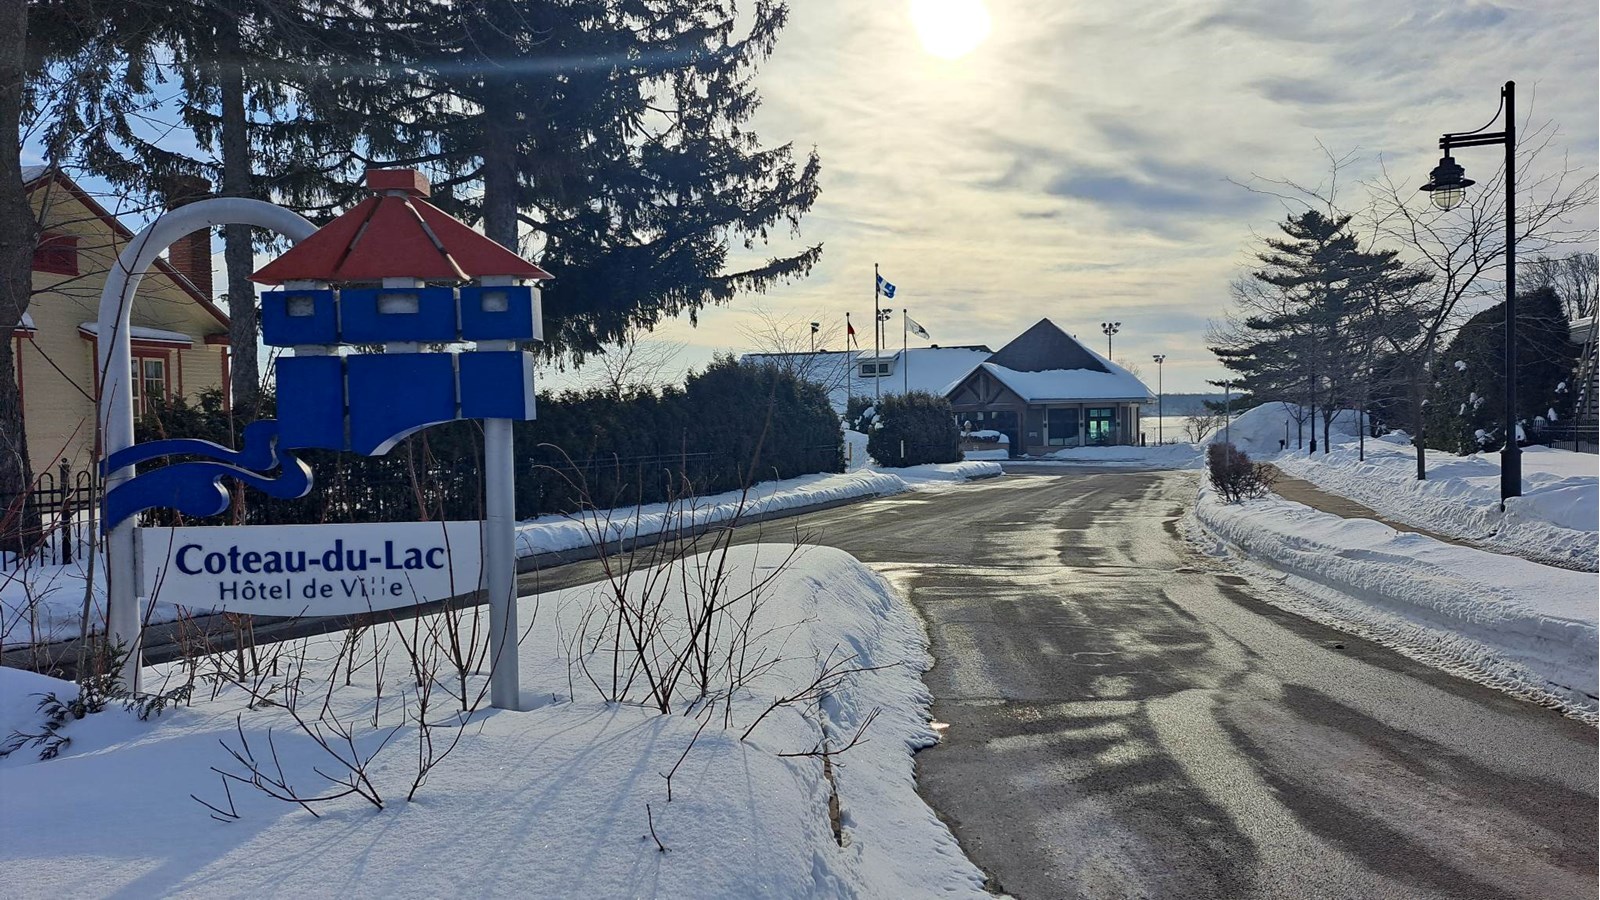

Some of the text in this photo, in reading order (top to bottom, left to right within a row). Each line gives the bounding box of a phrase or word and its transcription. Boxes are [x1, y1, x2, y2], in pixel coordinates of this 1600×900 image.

[175, 539, 445, 575] Coteau-du-Lac
[219, 578, 292, 601] Hôtel
[302, 578, 334, 599] de
